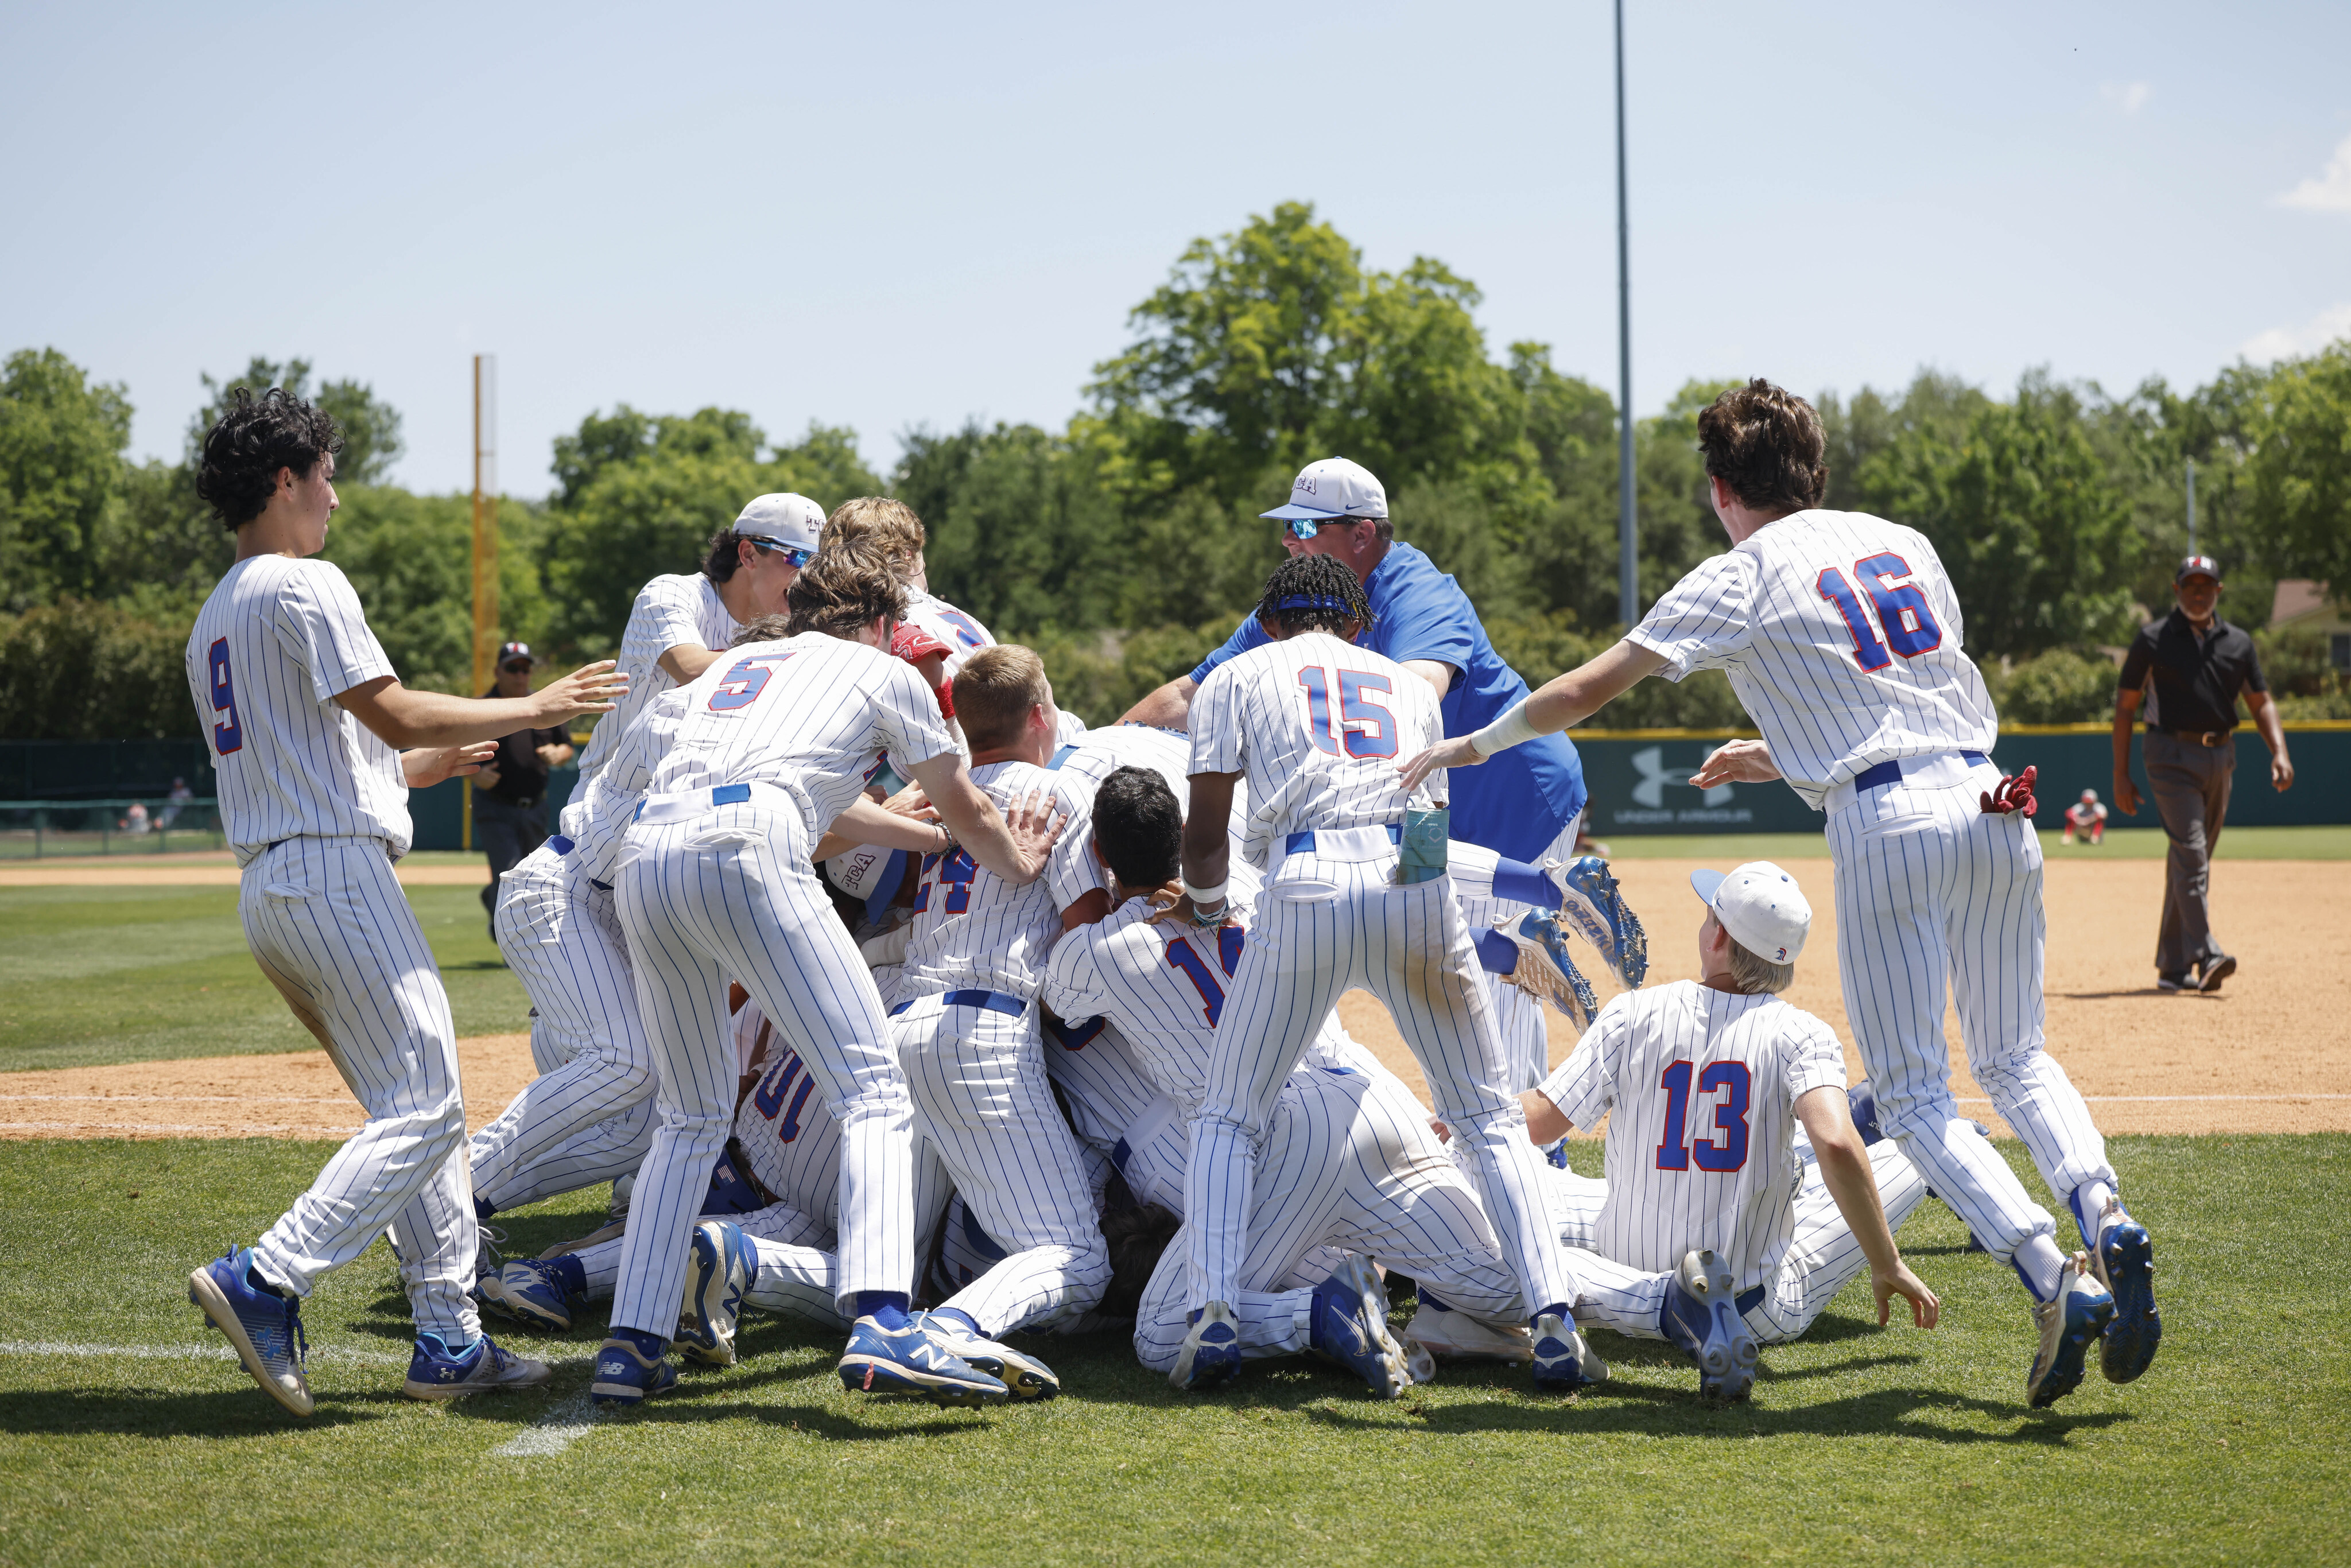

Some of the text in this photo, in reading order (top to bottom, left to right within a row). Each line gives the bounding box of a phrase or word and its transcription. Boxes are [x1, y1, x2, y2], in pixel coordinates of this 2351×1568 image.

[1292, 475, 1317, 495] CA
[1816, 551, 1943, 674] 16
[208, 636, 243, 756] 9
[708, 651, 797, 711] 5
[1298, 665, 1398, 759] 15
[841, 853, 876, 890] TCA
[1655, 1059, 1751, 1173] 13
[908, 1343, 951, 1371] N
